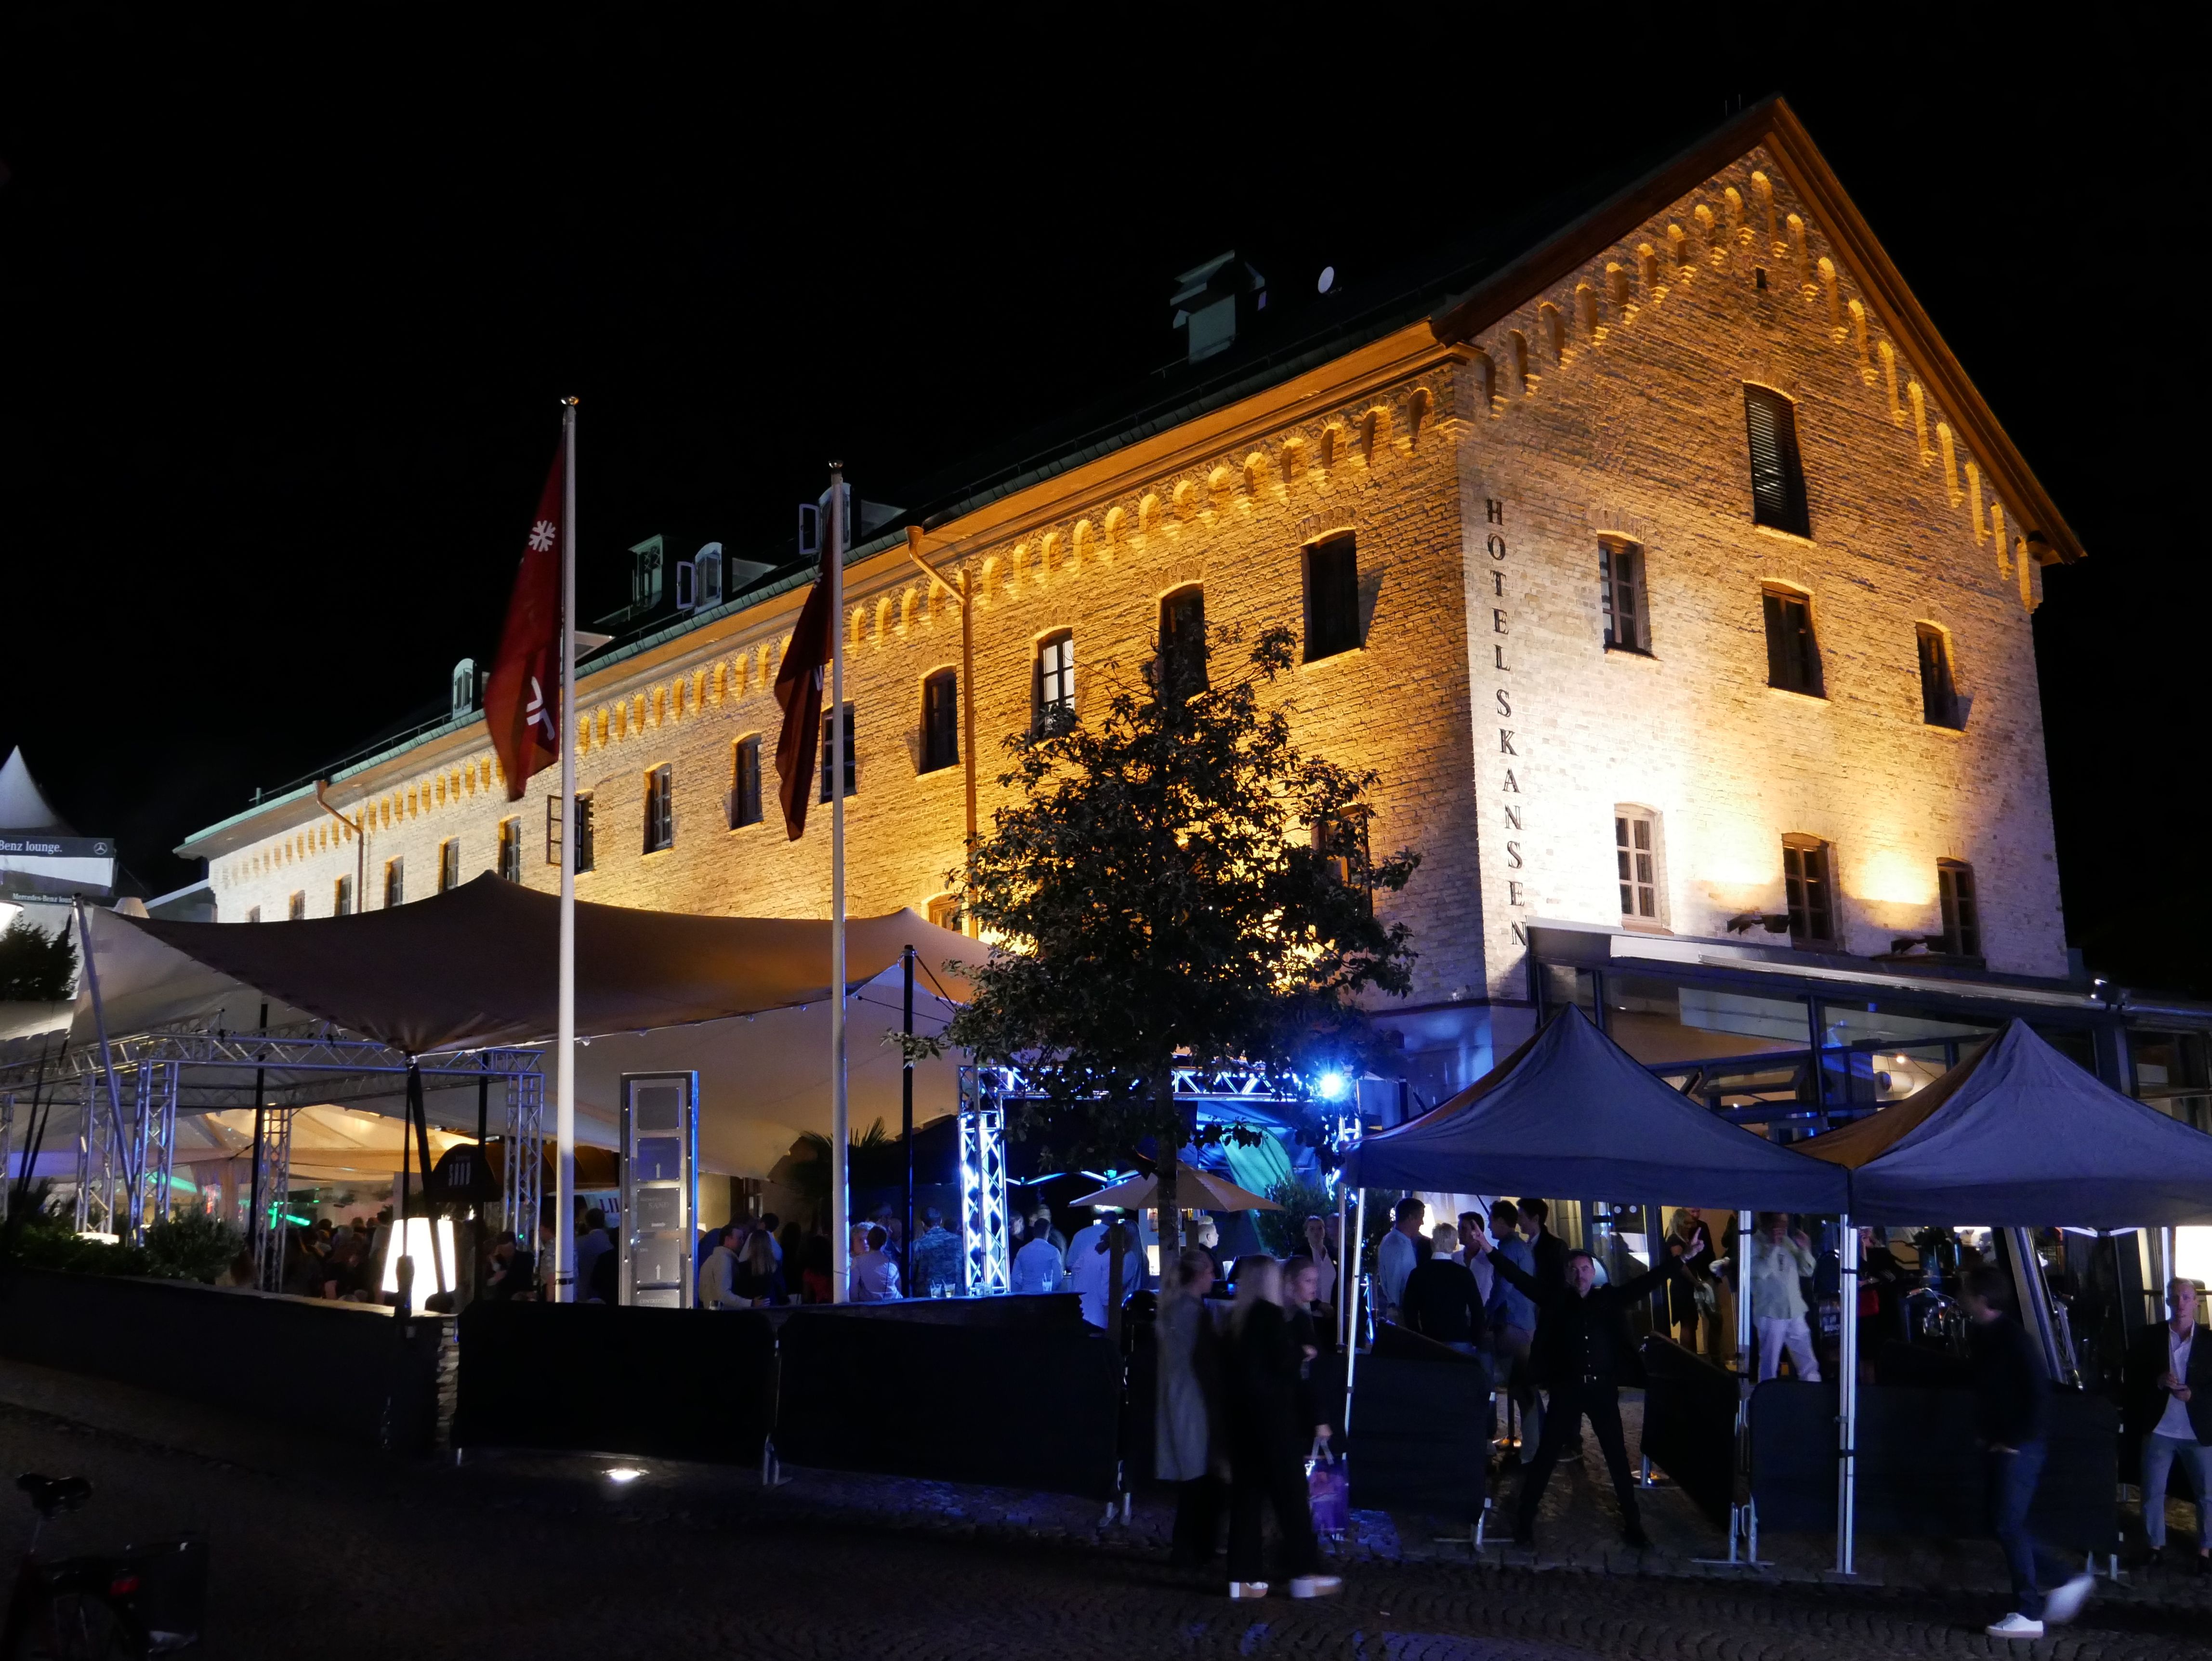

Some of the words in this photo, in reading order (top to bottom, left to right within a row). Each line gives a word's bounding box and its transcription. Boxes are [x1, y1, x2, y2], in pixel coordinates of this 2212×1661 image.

[1487, 498, 1511, 672] HOTEL
[25, 841, 63, 855] lounge.
[1496, 688, 1528, 946] SKANSEN
[13, 893, 57, 903] Mercedes-Benz
